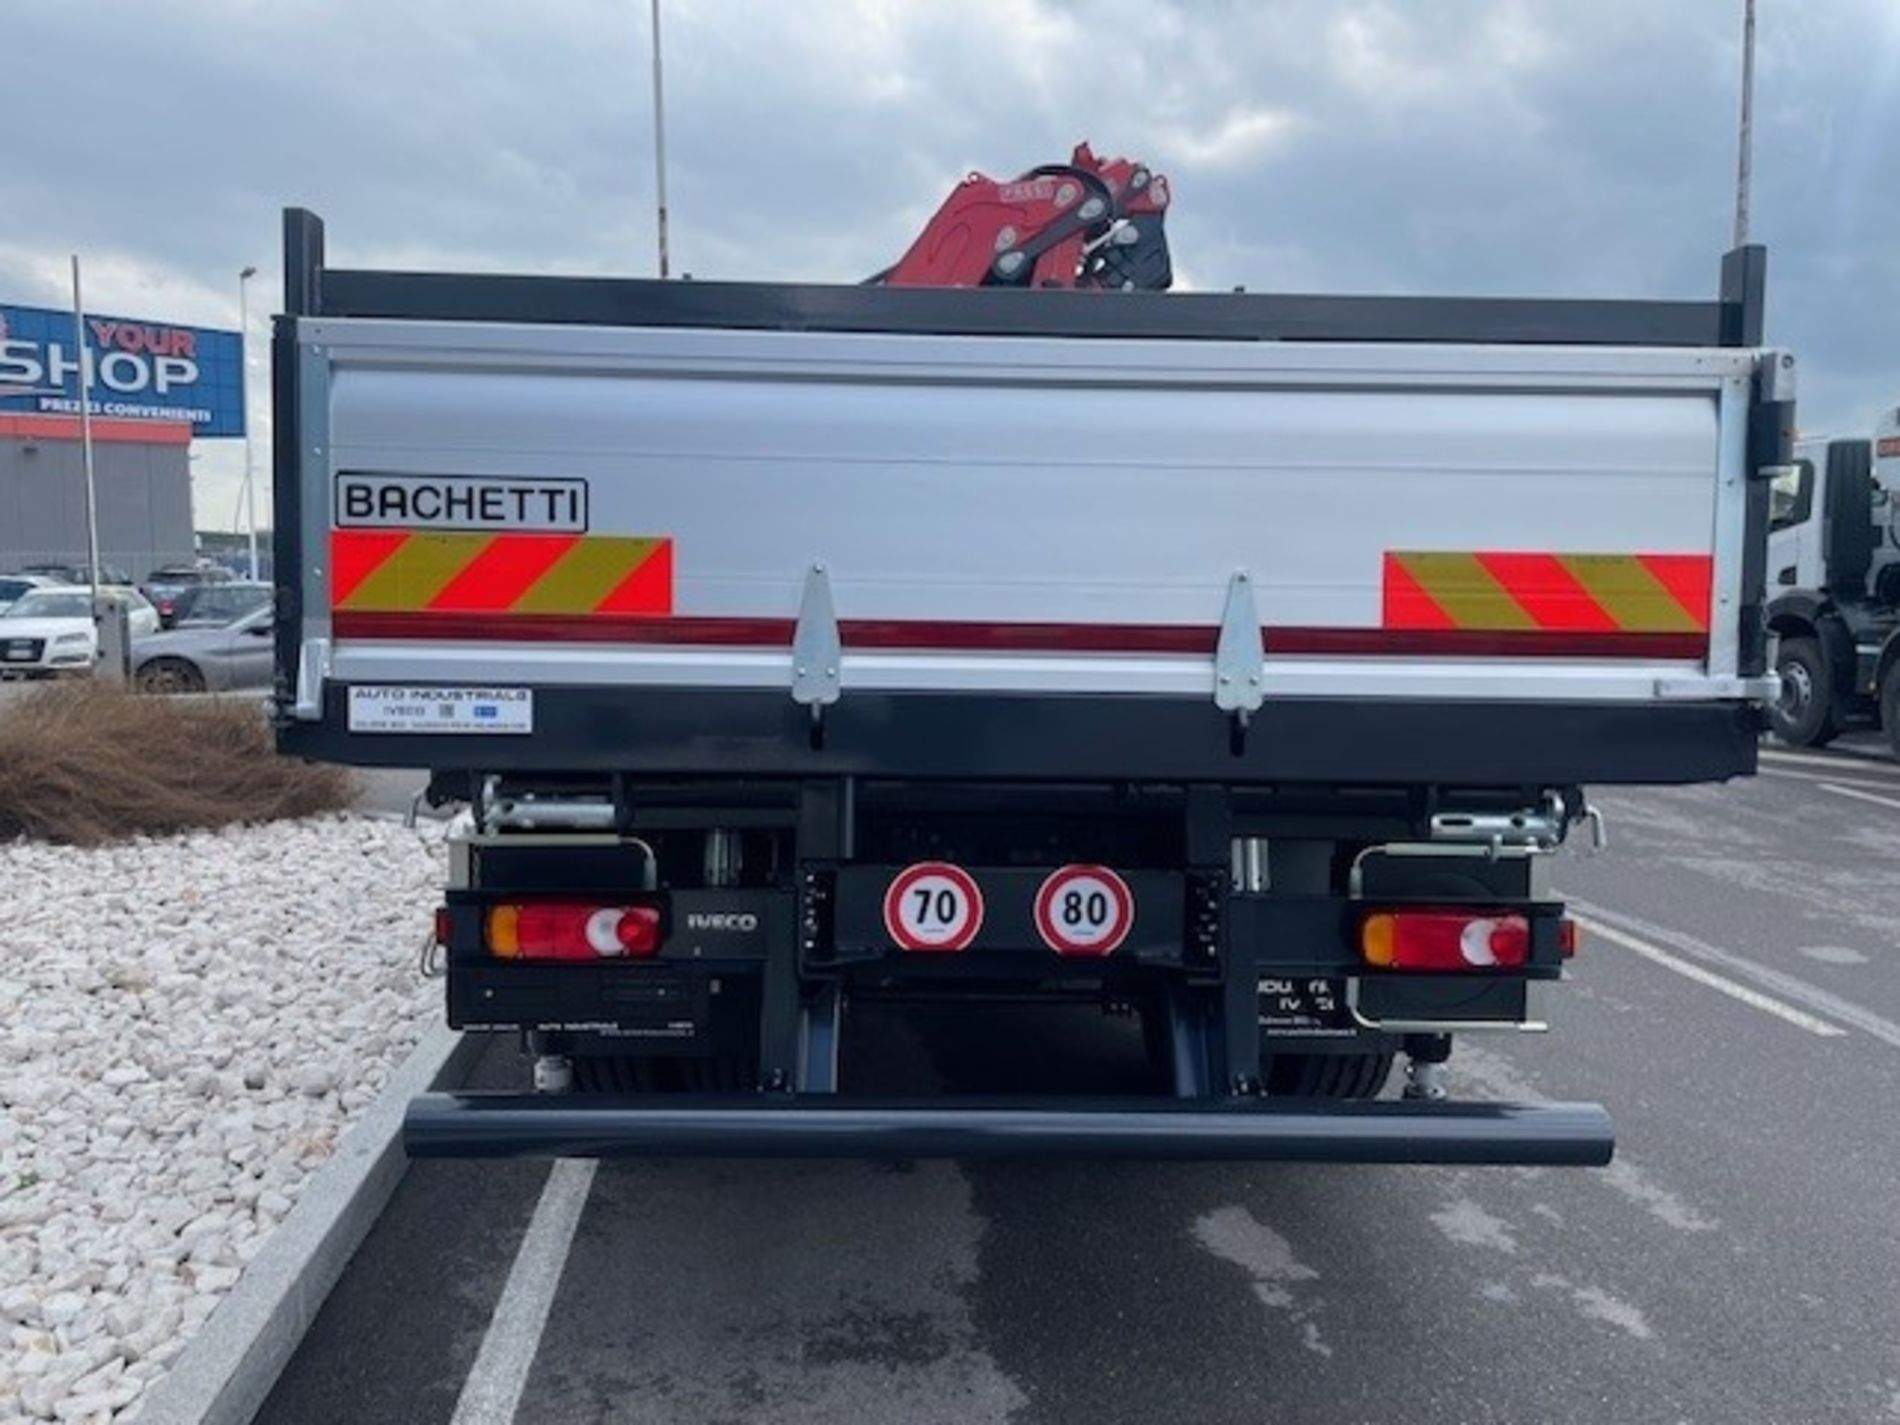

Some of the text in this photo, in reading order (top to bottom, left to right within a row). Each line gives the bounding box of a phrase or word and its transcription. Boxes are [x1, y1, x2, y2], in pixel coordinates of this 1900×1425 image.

[89, 320, 195, 356] YOUR
[346, 484, 577, 522] BACHETTI
[687, 913, 757, 931] IVECO
[913, 890, 957, 924] 70
[1063, 891, 1107, 926] 80
